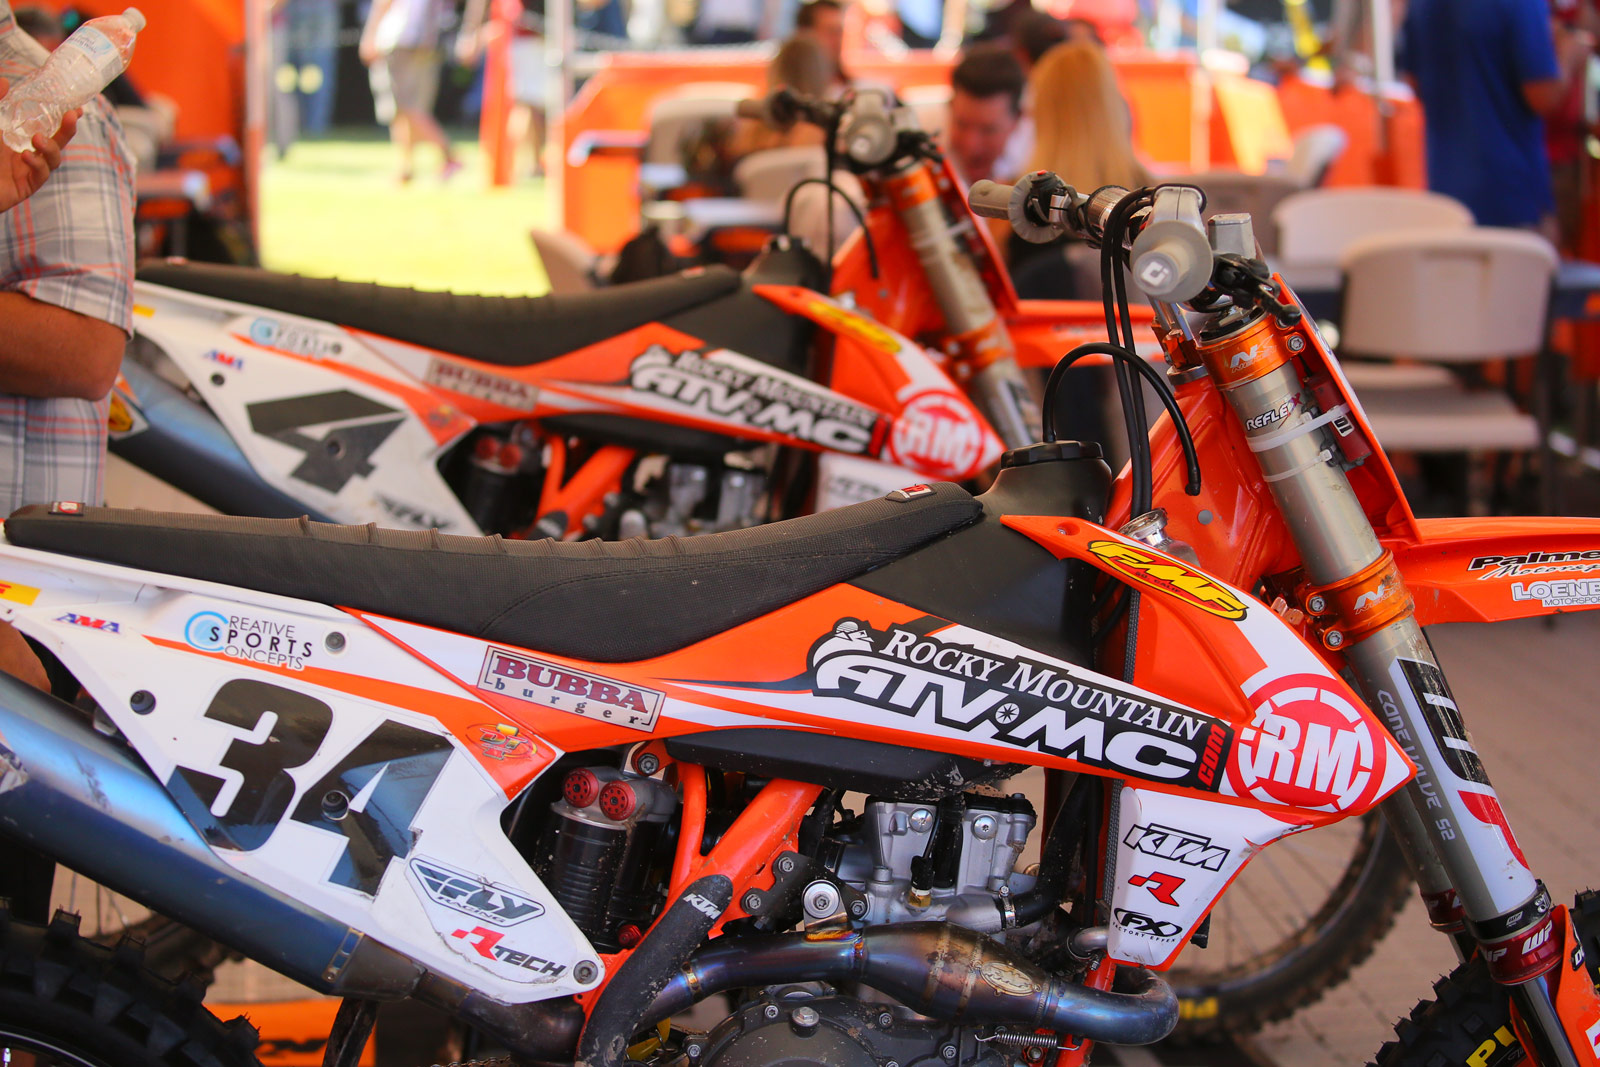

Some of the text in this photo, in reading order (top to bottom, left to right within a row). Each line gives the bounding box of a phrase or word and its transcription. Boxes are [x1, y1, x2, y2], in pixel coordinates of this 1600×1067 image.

[245, 389, 407, 494] 4
[1088, 543, 1250, 612] FMF
[1544, 597, 1600, 606] MOTORSPO
[55, 612, 120, 634] AMA
[209, 626, 312, 658] SPORTS
[492, 654, 648, 714] BUBBA
[494, 677, 641, 725] burger
[879, 629, 1207, 741] ROCKY MOUNTAIN
[816, 653, 1198, 780] ATV MC
[1377, 689, 1411, 745] CONE
[166, 678, 455, 897] 34
[1123, 822, 1231, 872] KTM
[415, 863, 541, 920] FLY
[437, 896, 505, 923] RACING
[683, 892, 722, 921] KTM
[1112, 921, 1146, 938] FACTORY
[1522, 919, 1553, 956] WP
